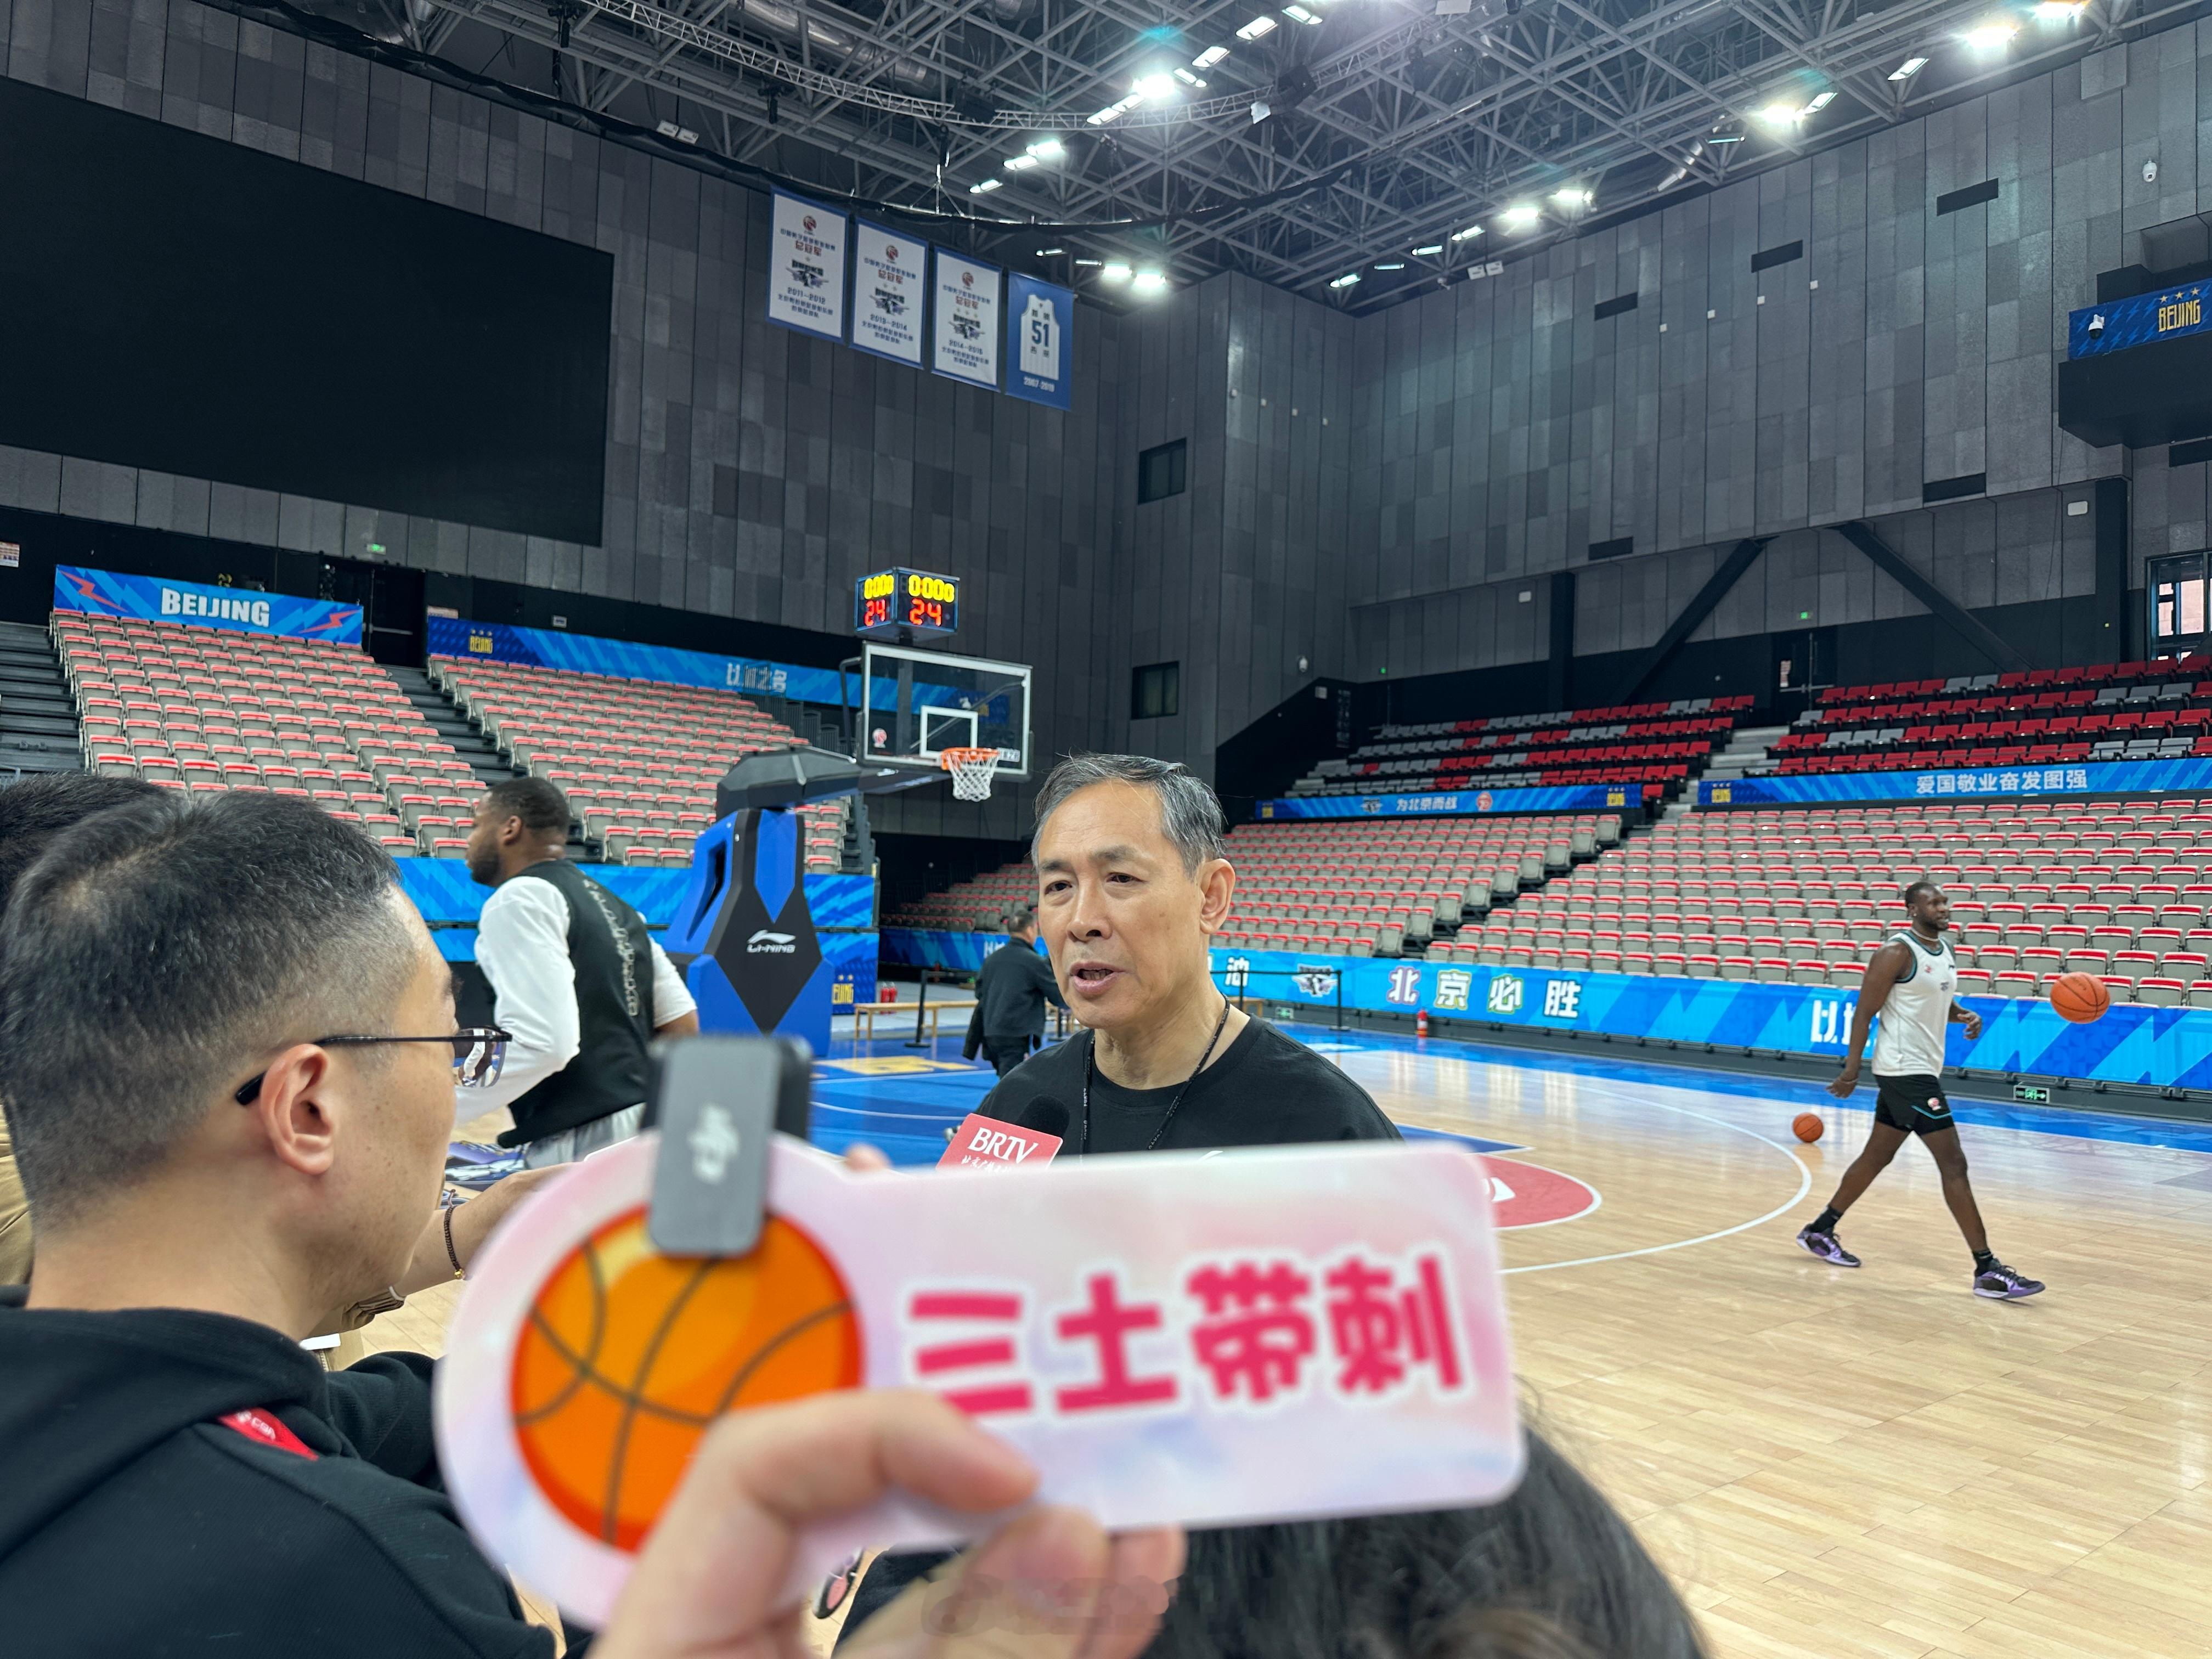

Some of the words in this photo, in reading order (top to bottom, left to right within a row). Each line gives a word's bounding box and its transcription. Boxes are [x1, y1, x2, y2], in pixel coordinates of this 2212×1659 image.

[2159, 299, 2200, 332] BEIJING
[1031, 320, 1049, 348] 51
[161, 587, 270, 628] BEIJING
[864, 599, 887, 627] 24
[909, 598, 943, 627] 24
[1916, 769, 2087, 794] 爱国敬业奋发图强
[747, 944, 795, 953] LI-NING
[1388, 968, 1581, 1019] 北京必胜
[967, 1127, 1039, 1164] BRTV
[910, 1255, 1463, 1417] 三土带刺
